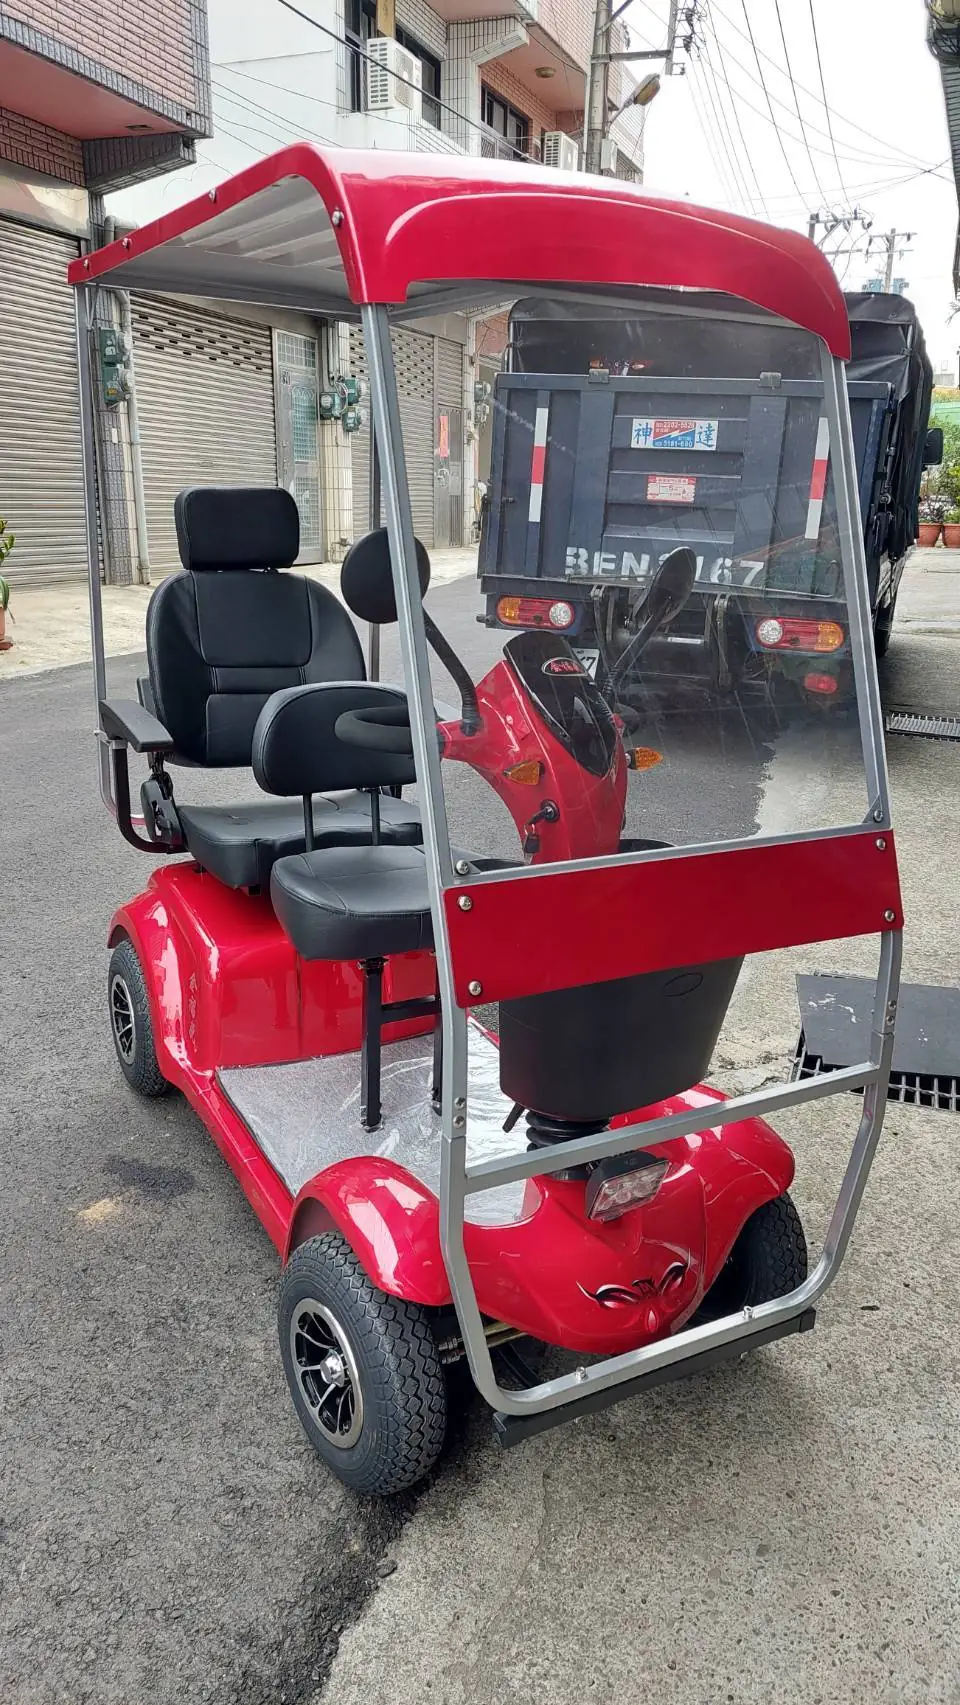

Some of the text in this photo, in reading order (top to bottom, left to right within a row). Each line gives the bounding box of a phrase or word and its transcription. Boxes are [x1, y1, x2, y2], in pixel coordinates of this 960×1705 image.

[633, 422, 715, 448] 神 達
[565, 546, 765, 586] BEN167
